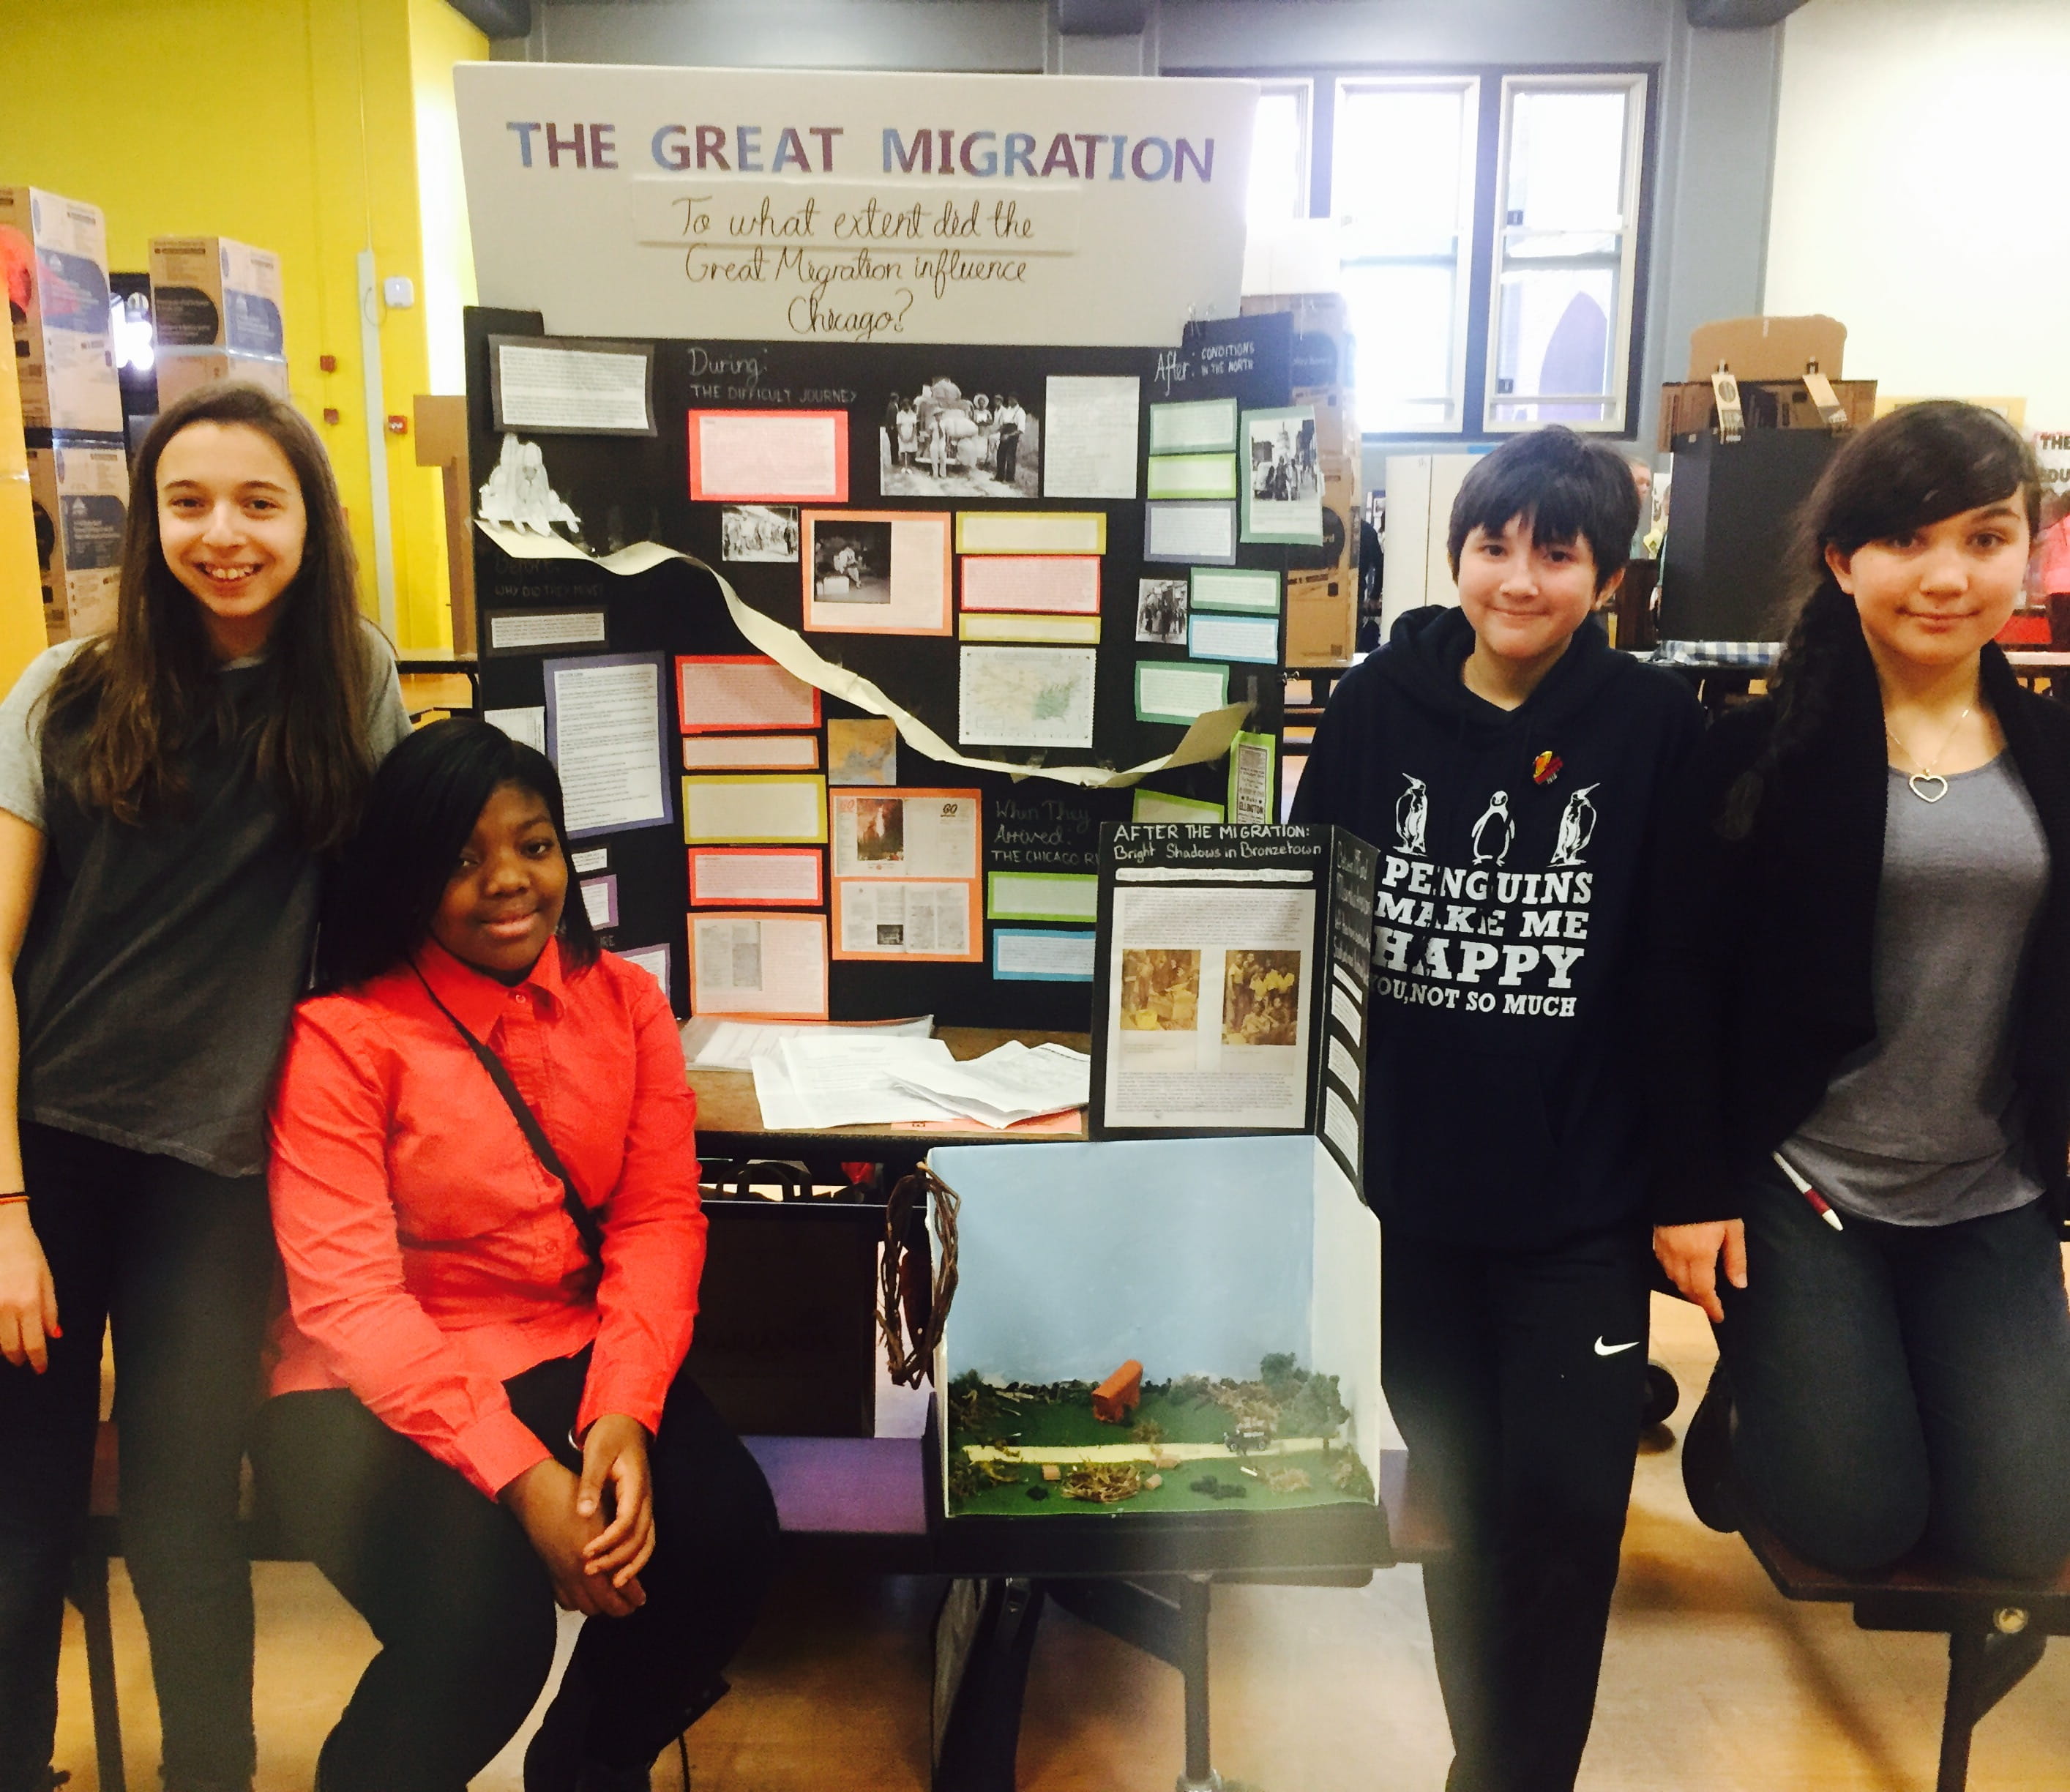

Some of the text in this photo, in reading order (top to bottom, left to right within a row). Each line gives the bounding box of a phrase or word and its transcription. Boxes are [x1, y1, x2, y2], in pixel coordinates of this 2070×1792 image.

[506, 122, 1215, 183] THE GREAT MIGRATION
[672, 195, 1035, 239] To what extent did the
[685, 242, 1027, 302] Great Migration influence
[787, 288, 914, 342] Chicago?
[1200, 340, 1255, 361] CONDITIONS
[1211, 361, 1225, 375] THE
[1228, 357, 1255, 373] NORTH
[690, 383, 858, 404] THE DIFFICULT JOURNEY
[941, 803, 958, 815] GO
[1042, 799, 1091, 834] They
[1113, 824, 1311, 843] AFTER THE MIGRATION:
[990, 849, 1023, 863] THE
[1025, 850, 1081, 866] CHICAGO
[1113, 840, 1322, 864] Bright Shadows in Bronzetown
[1380, 855, 1593, 905] PENGUINS
[1374, 891, 1506, 937] MAKE
[1519, 910, 1590, 940] ME
[1372, 926, 1585, 989] HAPPY
[1465, 991, 1496, 1013] SO
[1502, 993, 1577, 1018] MUCH
